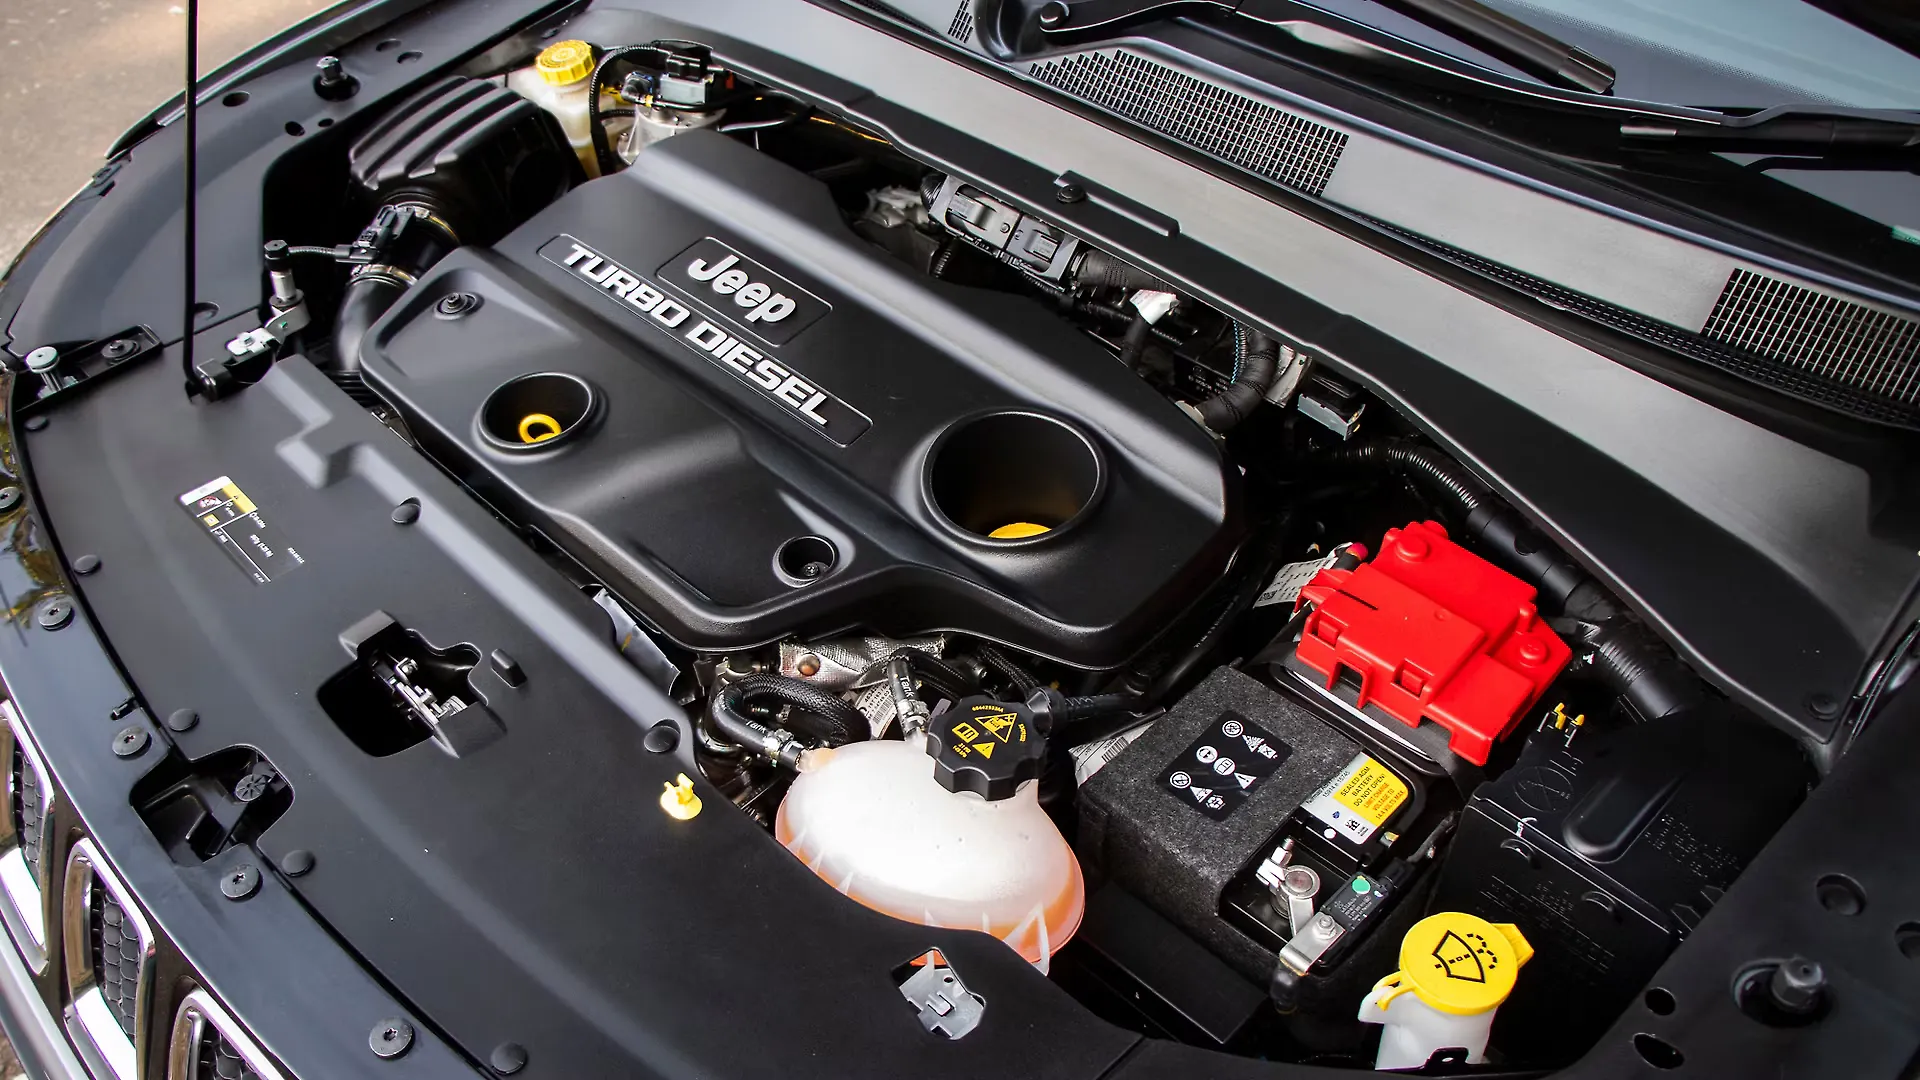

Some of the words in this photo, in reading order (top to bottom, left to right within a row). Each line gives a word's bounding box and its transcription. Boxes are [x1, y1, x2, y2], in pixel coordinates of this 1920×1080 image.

[687, 254, 797, 324] Jeep
[563, 243, 691, 329] TURBO
[685, 320, 828, 426] DIESEL
[900, 675, 915, 698] Tank
[745, 720, 767, 734] Tank
[1340, 777, 1360, 797] SEALED
[1352, 774, 1374, 797] BATTERY
[1353, 796, 1363, 807] DO
[1363, 787, 1374, 799] NOT
